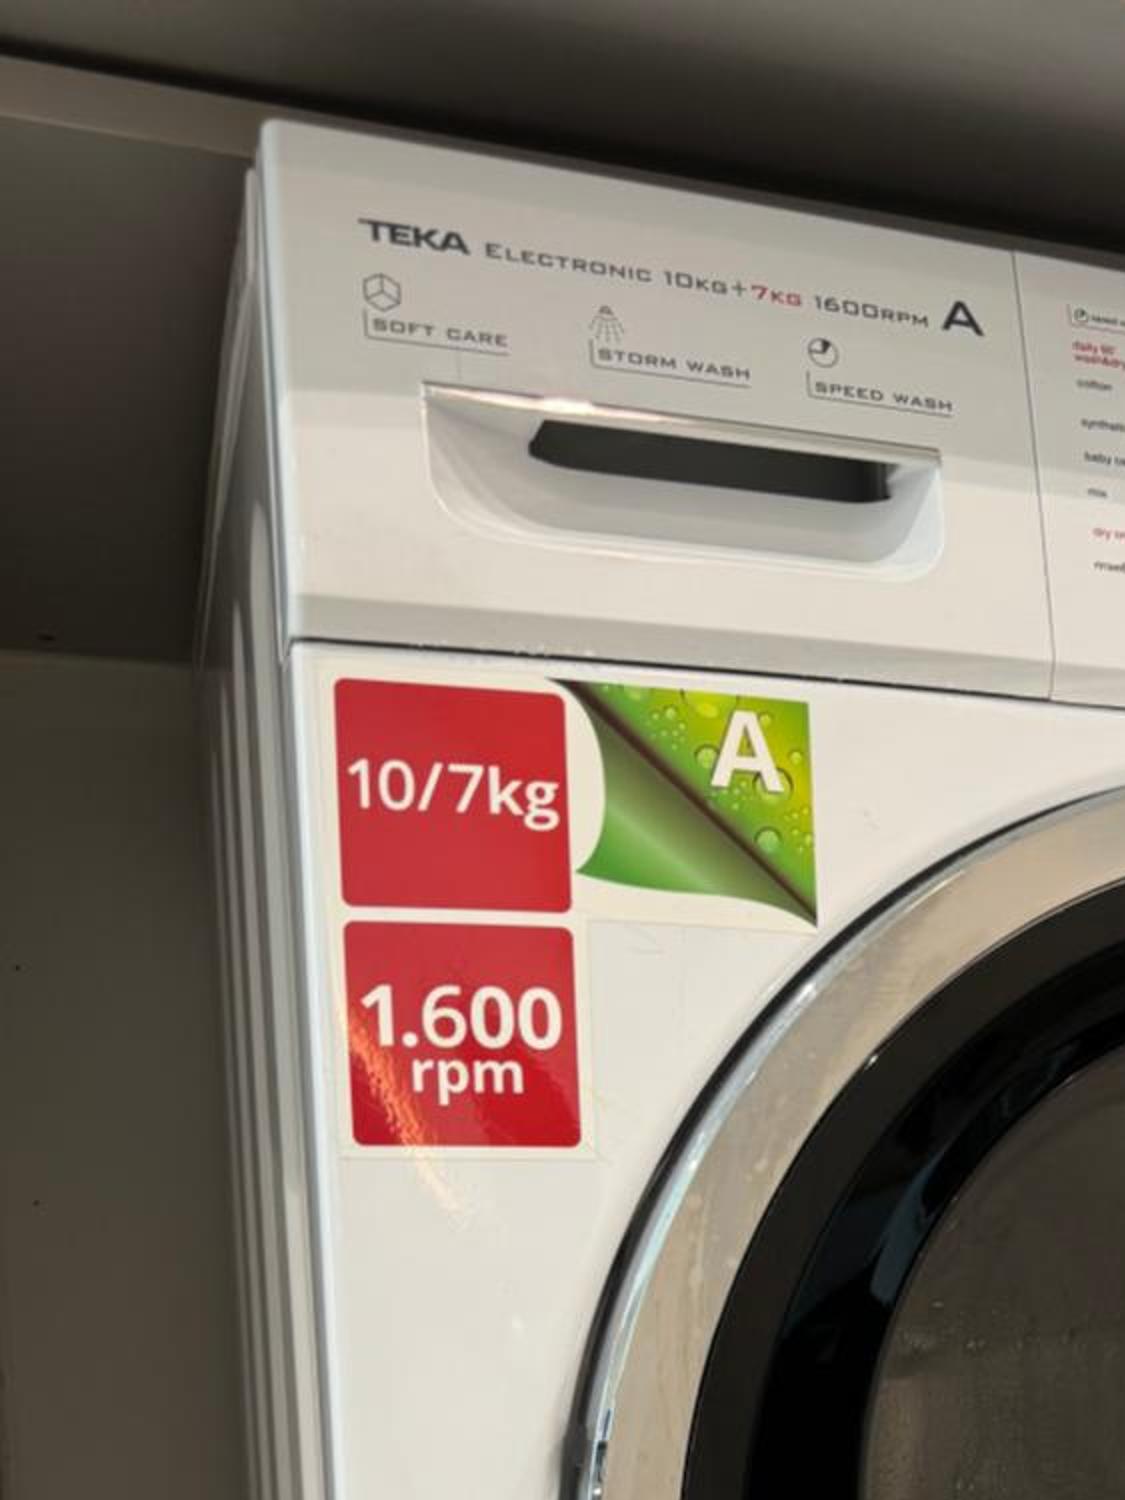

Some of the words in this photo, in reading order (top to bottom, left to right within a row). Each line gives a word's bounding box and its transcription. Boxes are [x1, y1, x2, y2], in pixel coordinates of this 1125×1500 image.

[358, 217, 471, 255] TEKA
[485, 242, 652, 282] ELECTRONIC
[814, 295, 930, 328] 1600RPM
[941, 301, 984, 336] A
[373, 317, 434, 338] SOFT
[446, 325, 509, 347] CARE
[597, 347, 677, 371] STORM
[687, 361, 751, 381] WASH
[814, 380, 885, 403] SPEED
[893, 392, 954, 412] WASH
[710, 709, 785, 794] A
[348, 758, 560, 832] 10/7kg
[360, 984, 563, 1052] 1.600
[411, 1057, 525, 1107] rpm
